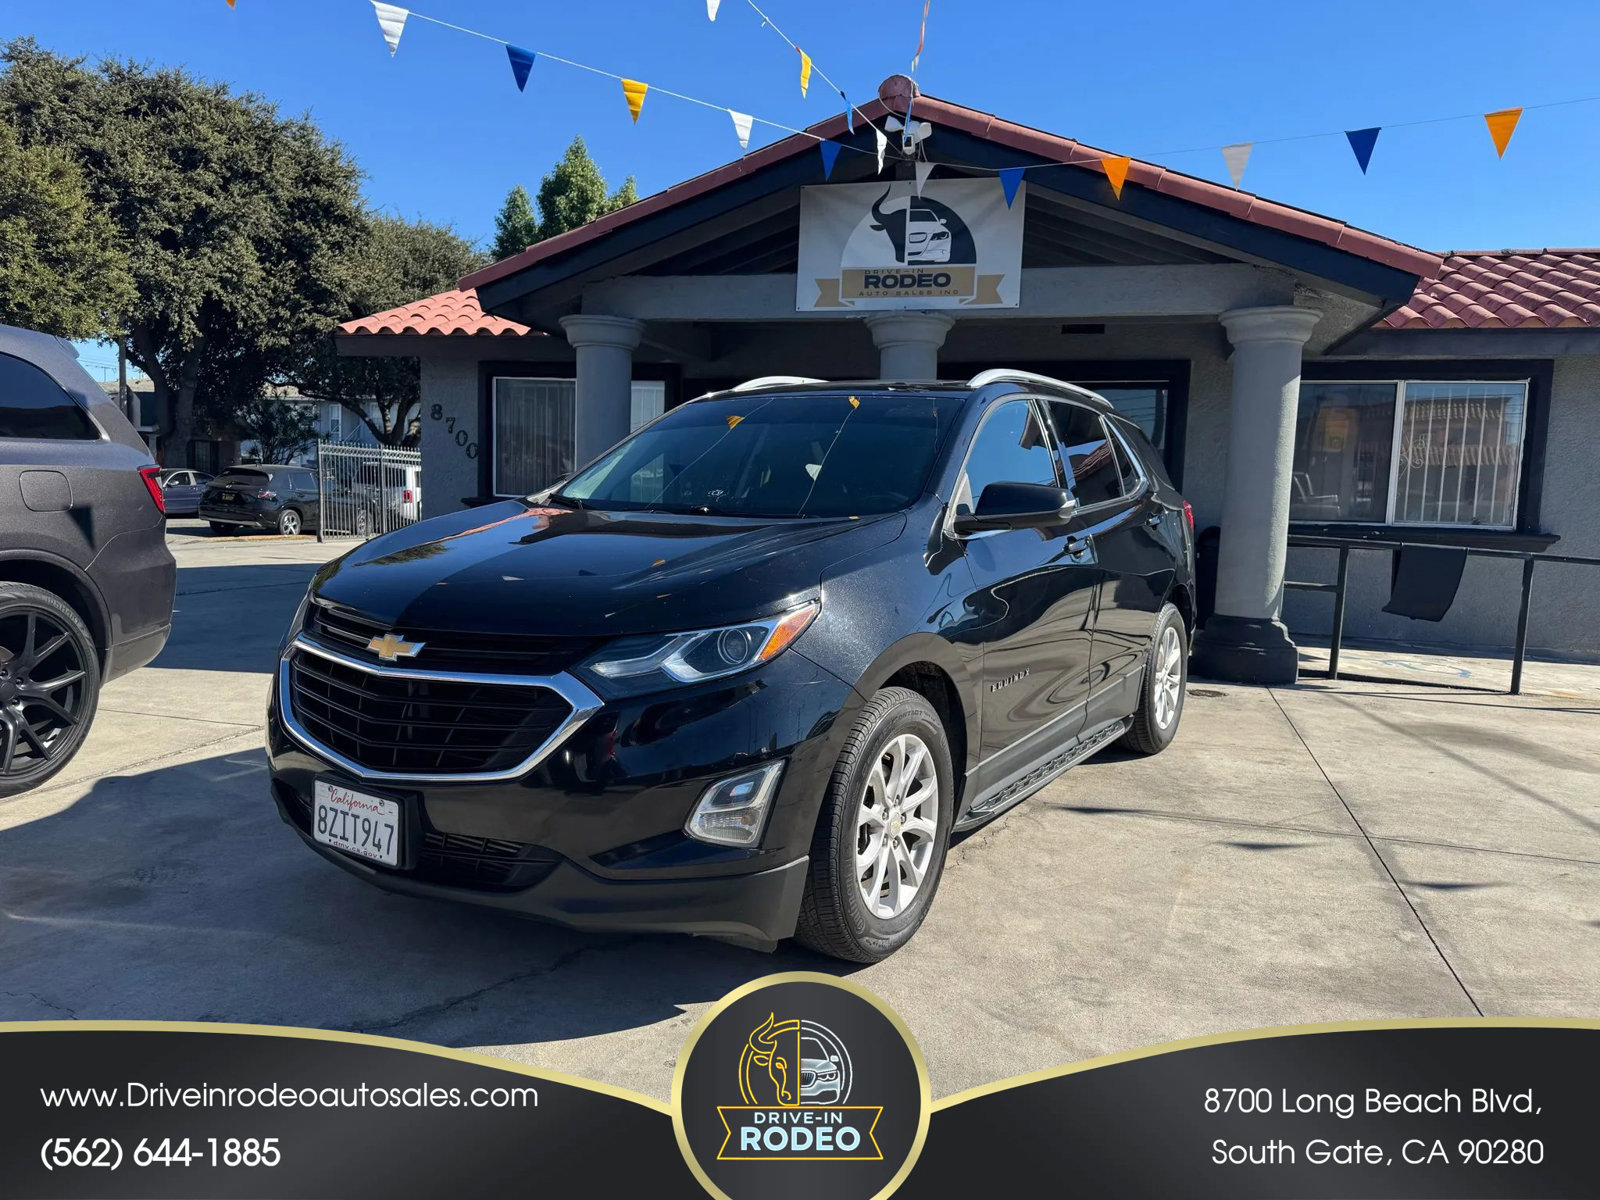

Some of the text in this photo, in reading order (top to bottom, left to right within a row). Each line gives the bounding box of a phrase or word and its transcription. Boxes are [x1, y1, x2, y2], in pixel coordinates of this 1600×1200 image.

[864, 272, 951, 290] RODEO
[430, 403, 481, 460] 8700
[330, 788, 385, 815] California
[318, 805, 394, 855] 8ZIT947
